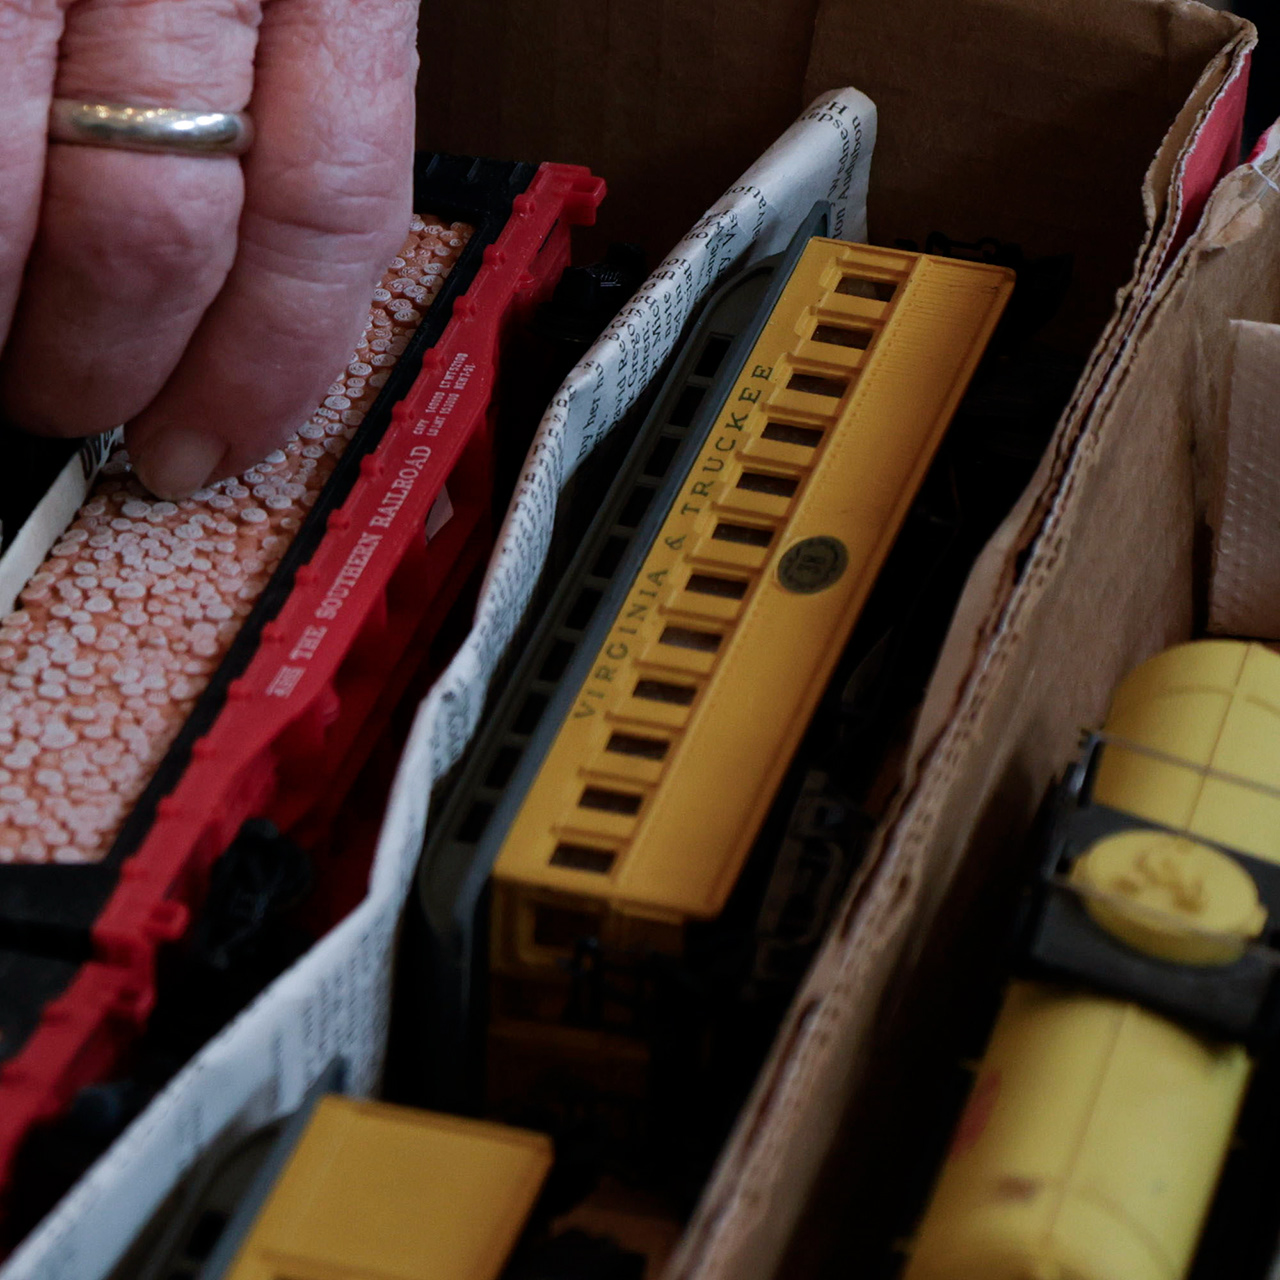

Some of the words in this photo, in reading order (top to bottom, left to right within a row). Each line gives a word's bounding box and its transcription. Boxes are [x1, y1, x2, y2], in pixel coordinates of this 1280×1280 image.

[290, 624, 328, 660] THE
[315, 531, 383, 620] SOUTHERN
[369, 445, 432, 530] RAILROAD
[573, 566, 668, 721] VIRGINIA
[664, 534, 686, 552] &
[680, 362, 774, 520] TRUCKEE
